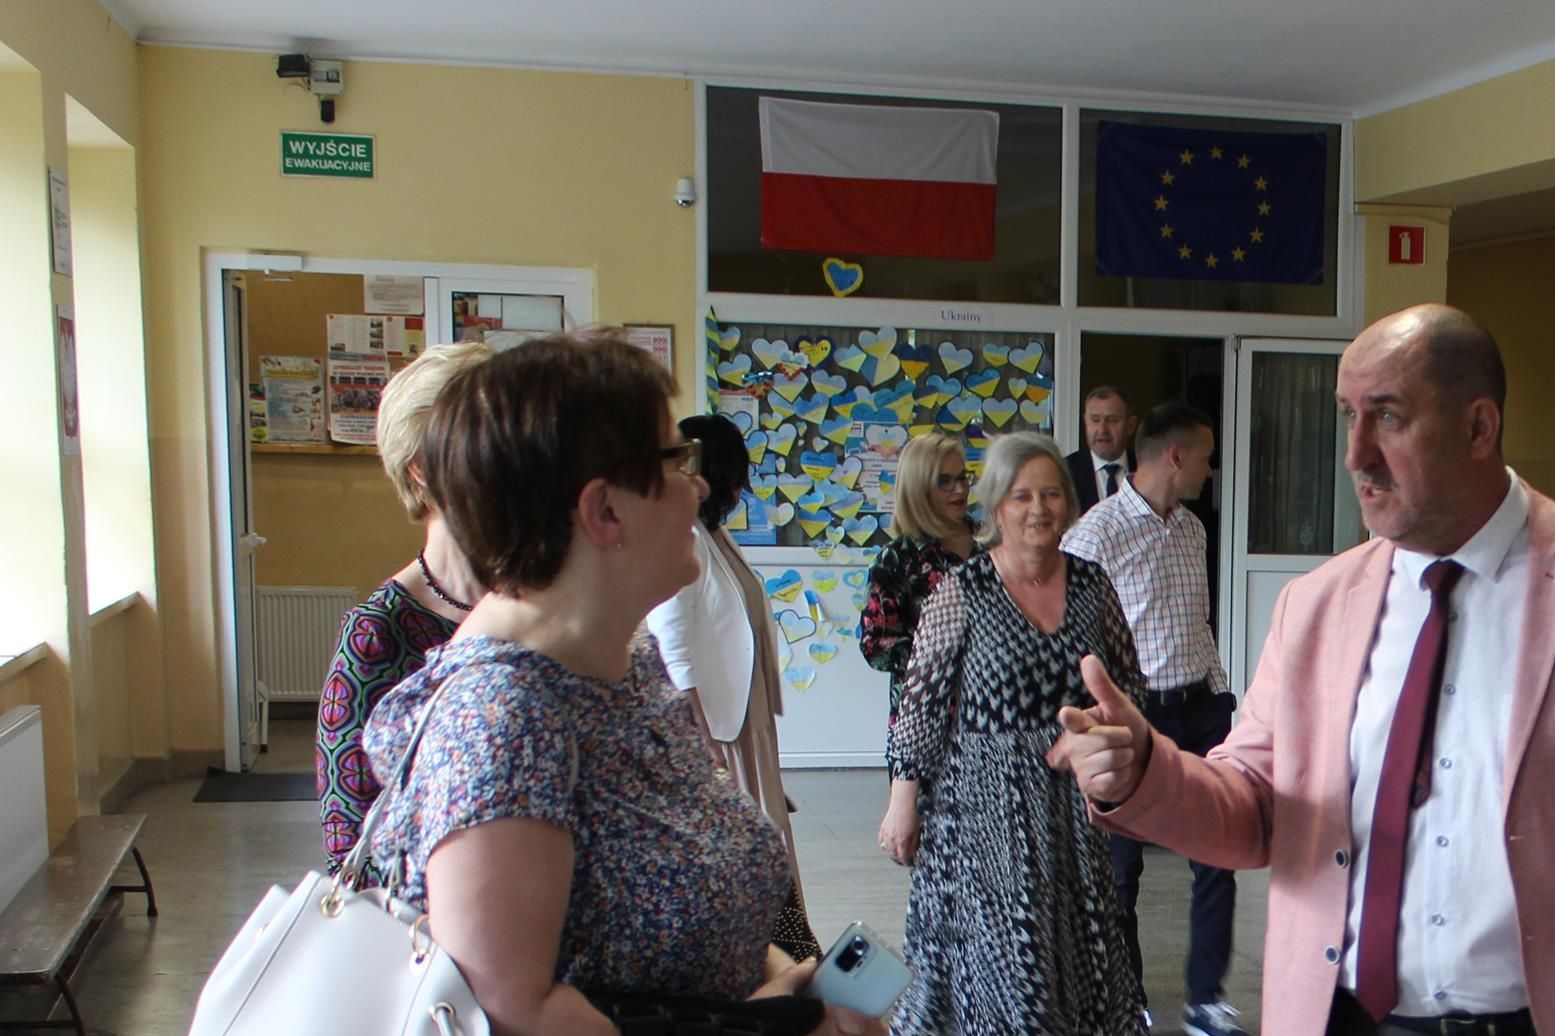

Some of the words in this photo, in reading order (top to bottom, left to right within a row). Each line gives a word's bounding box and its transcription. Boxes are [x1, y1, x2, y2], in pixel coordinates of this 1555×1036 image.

[289, 139, 367, 158] WYJŚCIE
[285, 158, 371, 172] EWAKUACYJNE
[940, 309, 981, 324] Ukrainy
